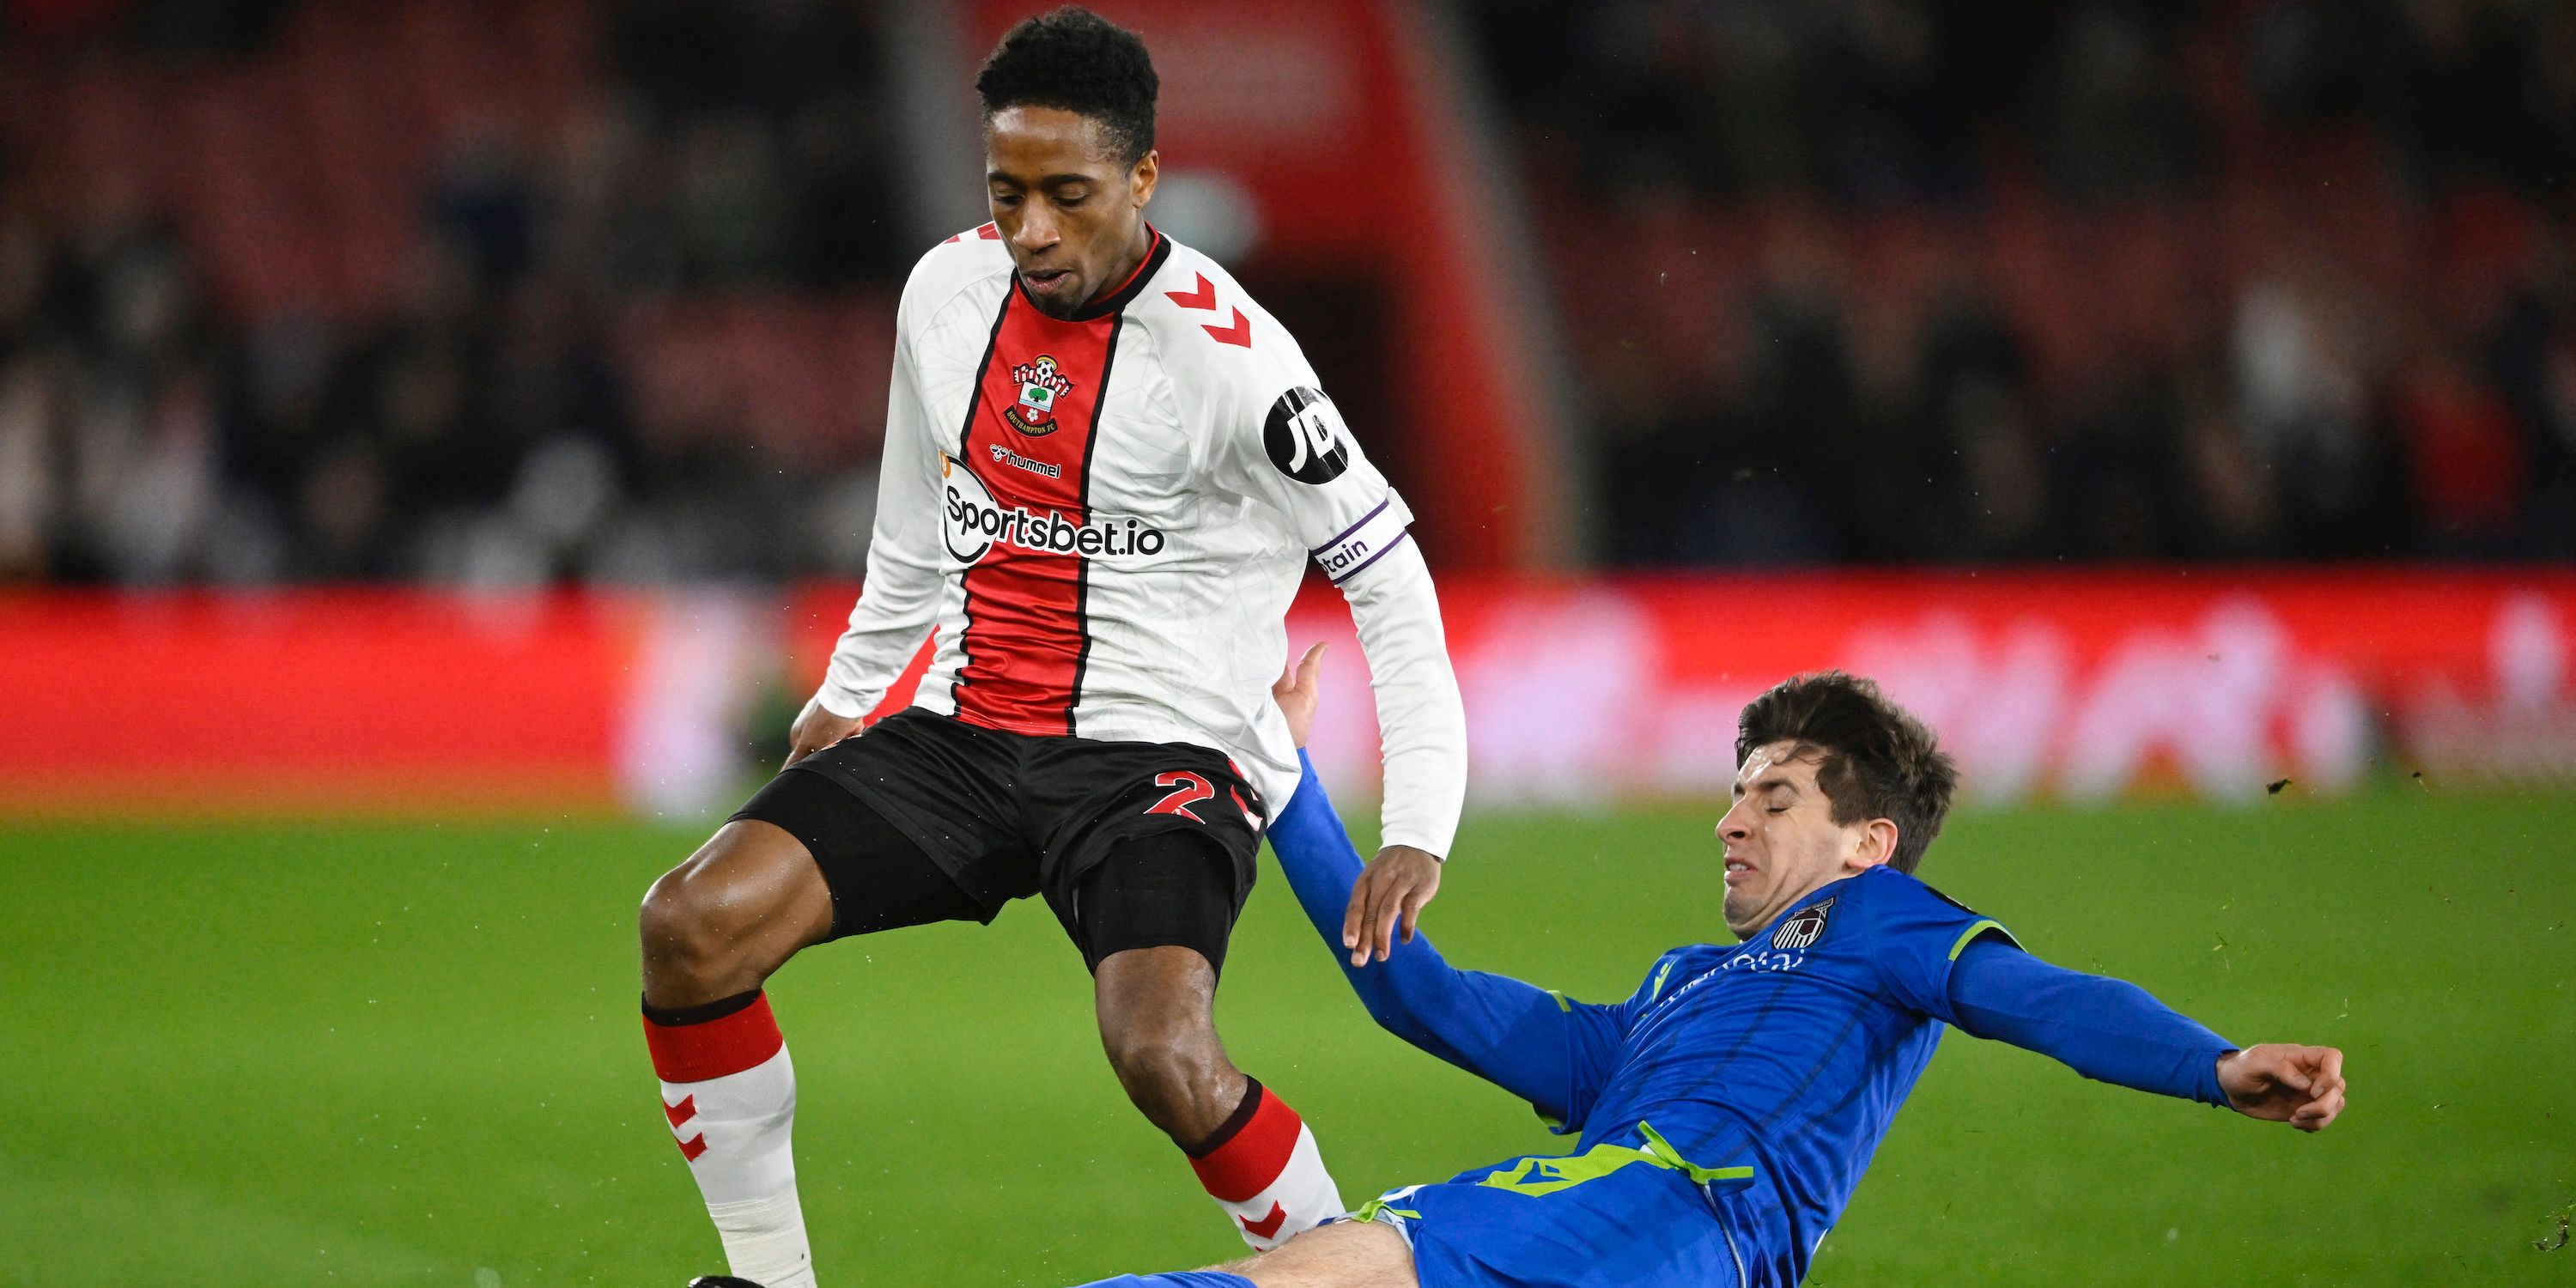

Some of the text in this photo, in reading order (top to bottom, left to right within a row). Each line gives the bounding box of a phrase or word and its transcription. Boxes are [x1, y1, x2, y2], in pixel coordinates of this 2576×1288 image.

[1006, 410, 1055, 434] SOUTHAMPTON FC
[1286, 401, 1335, 474] JD
[1007, 450, 1060, 478] hummel
[946, 485, 1165, 556] Sportsbet.io
[1143, 770, 1215, 825] 2
